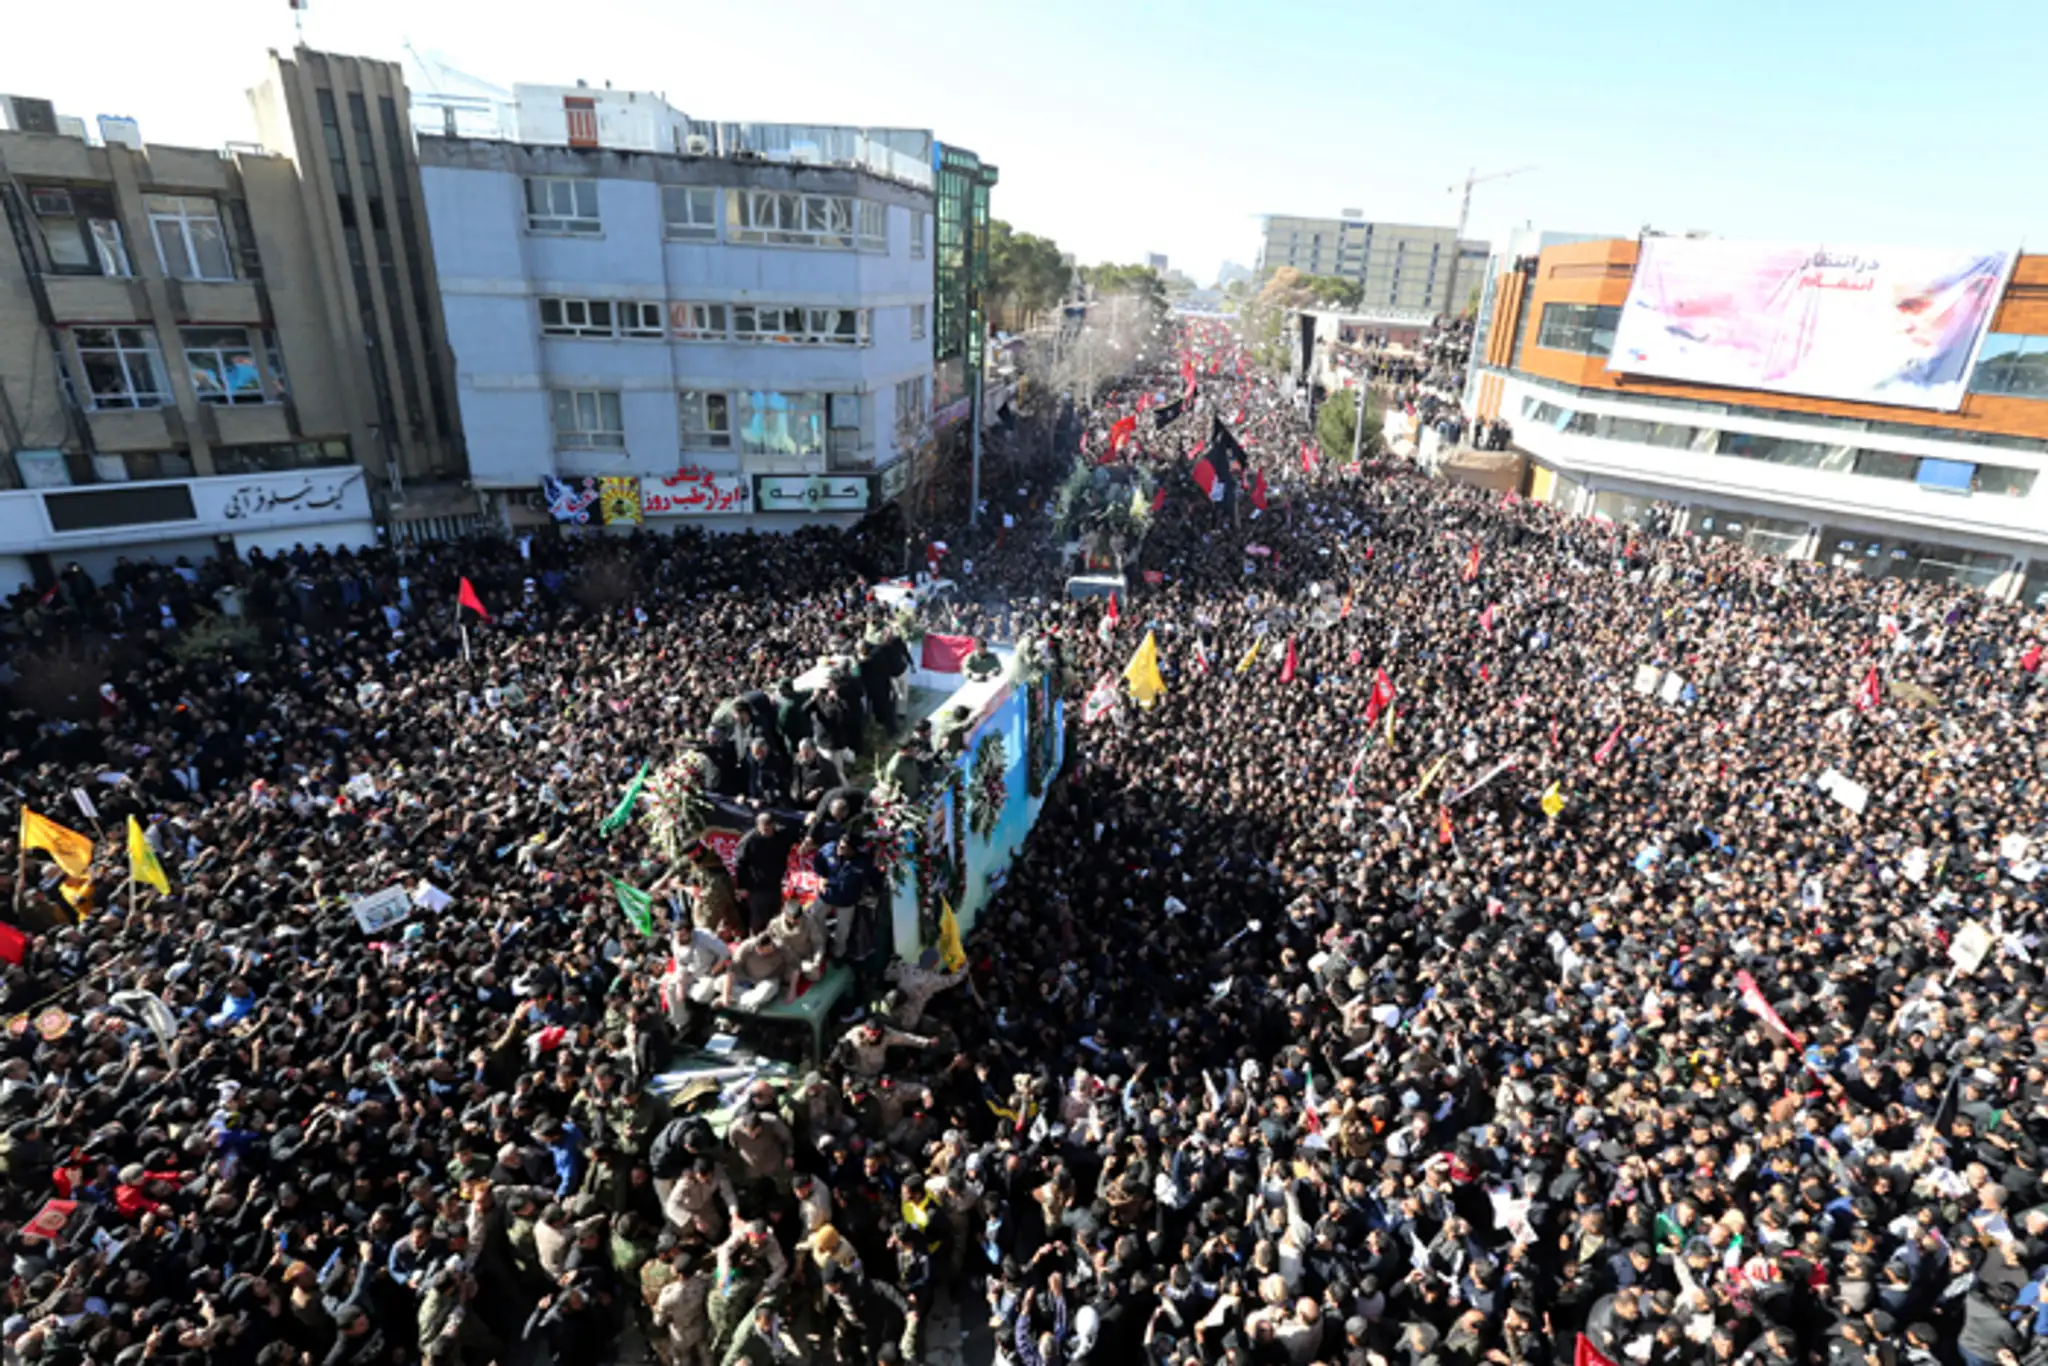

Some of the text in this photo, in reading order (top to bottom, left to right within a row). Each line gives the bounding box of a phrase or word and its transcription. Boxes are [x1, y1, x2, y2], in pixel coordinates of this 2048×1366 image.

[307, 469, 364, 511] کیف
[644, 490, 671, 512] روز
[672, 486, 706, 511] طب
[704, 486, 741, 512] ابزار
